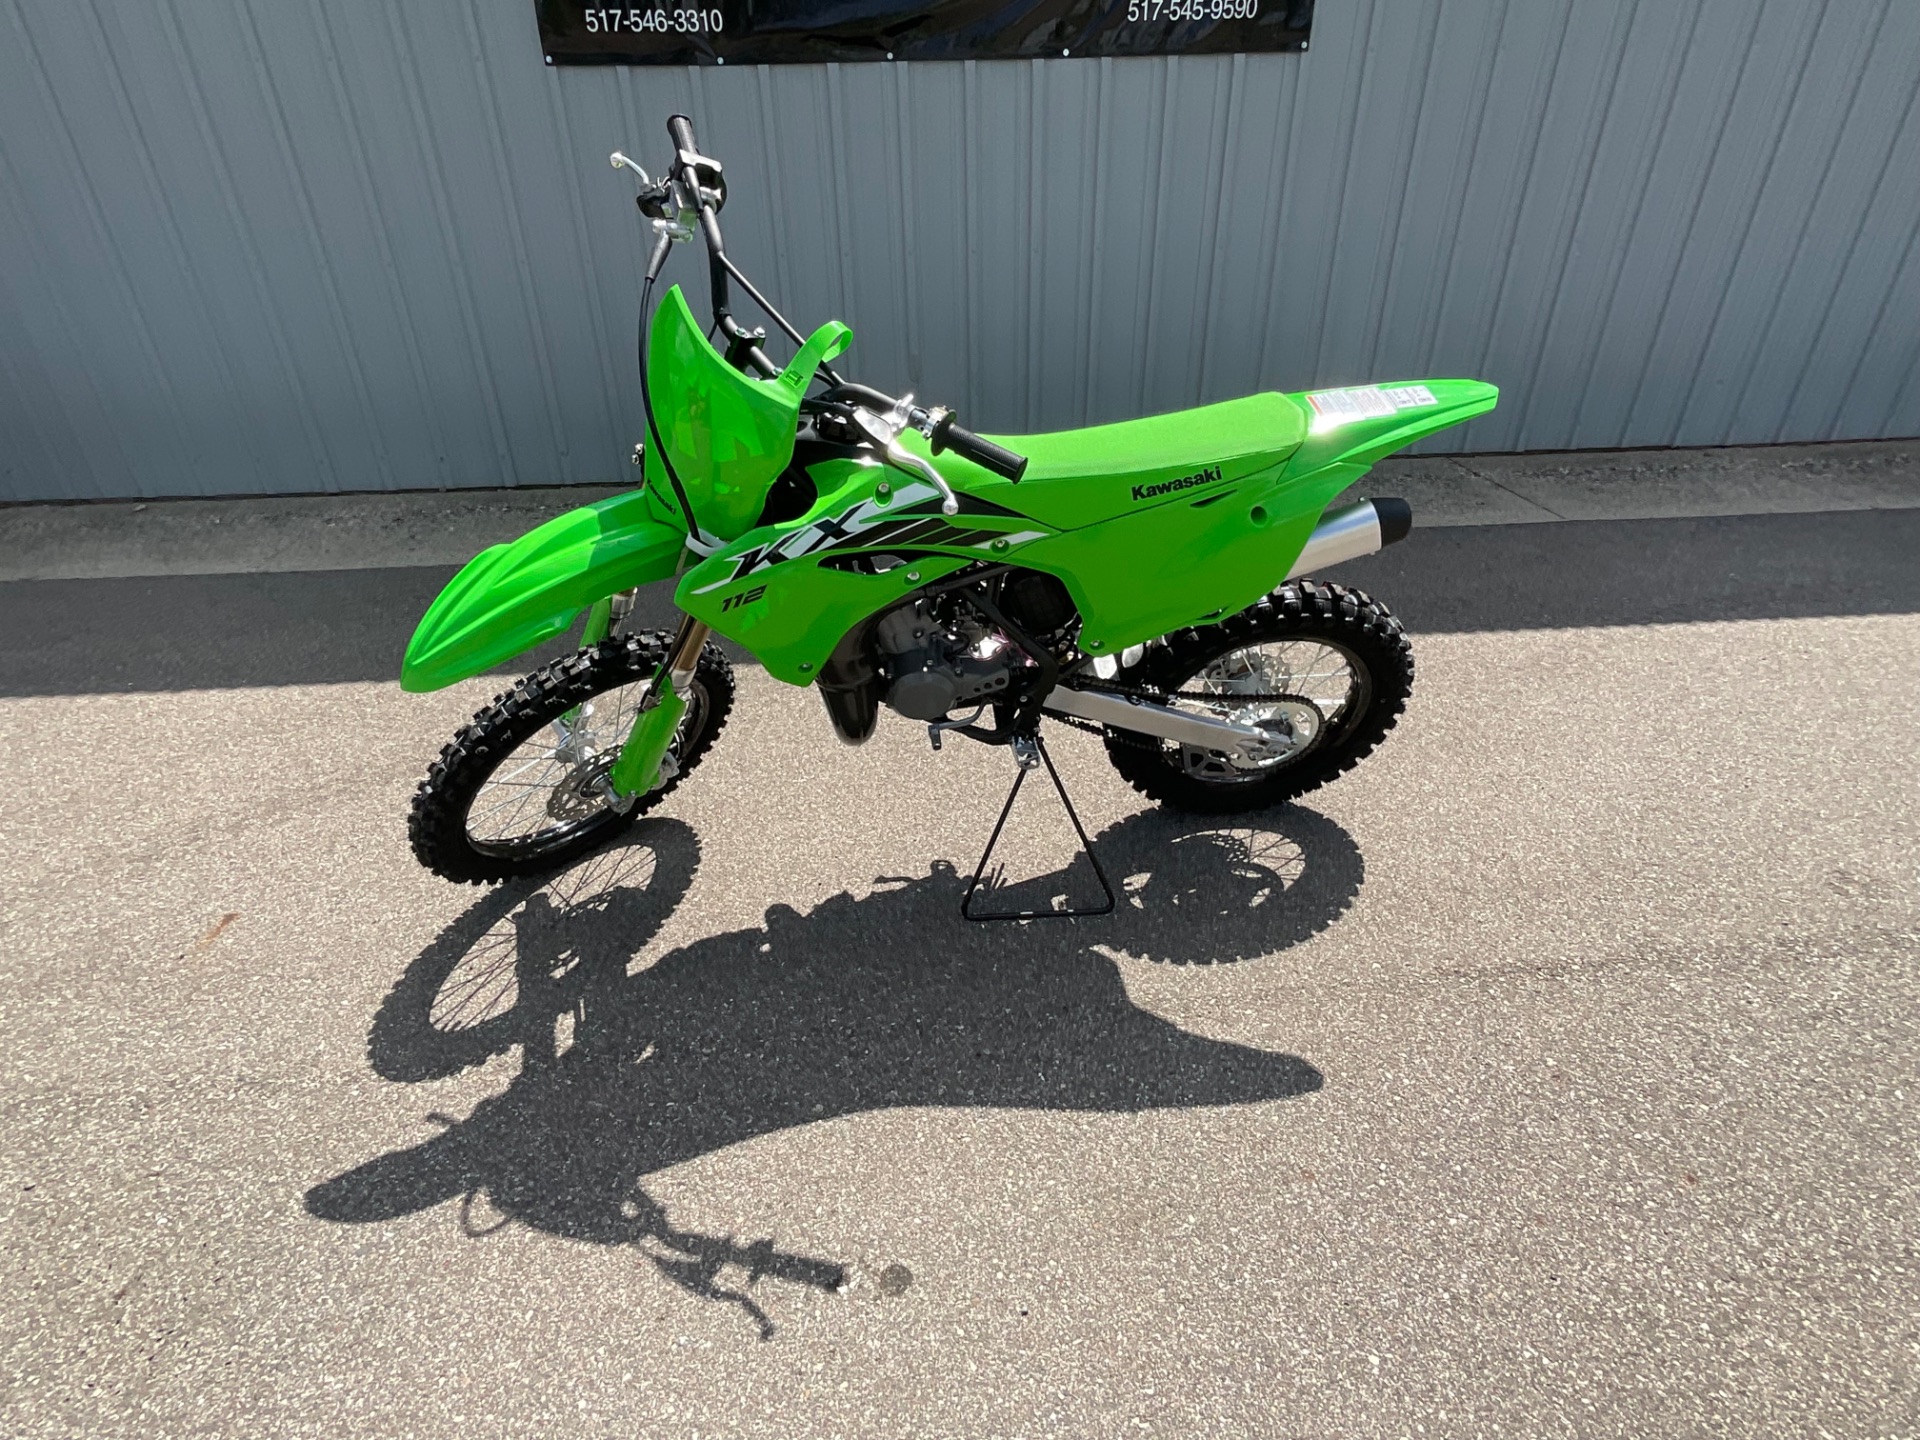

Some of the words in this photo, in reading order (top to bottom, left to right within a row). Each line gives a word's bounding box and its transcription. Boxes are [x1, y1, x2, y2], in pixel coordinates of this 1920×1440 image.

[585, 9, 723, 32] 517-546-3310
[1127, 0, 1258, 21] 517-545-9590
[1131, 466, 1222, 501] Kawasaki
[728, 500, 871, 583] KX
[722, 585, 767, 612] 112
